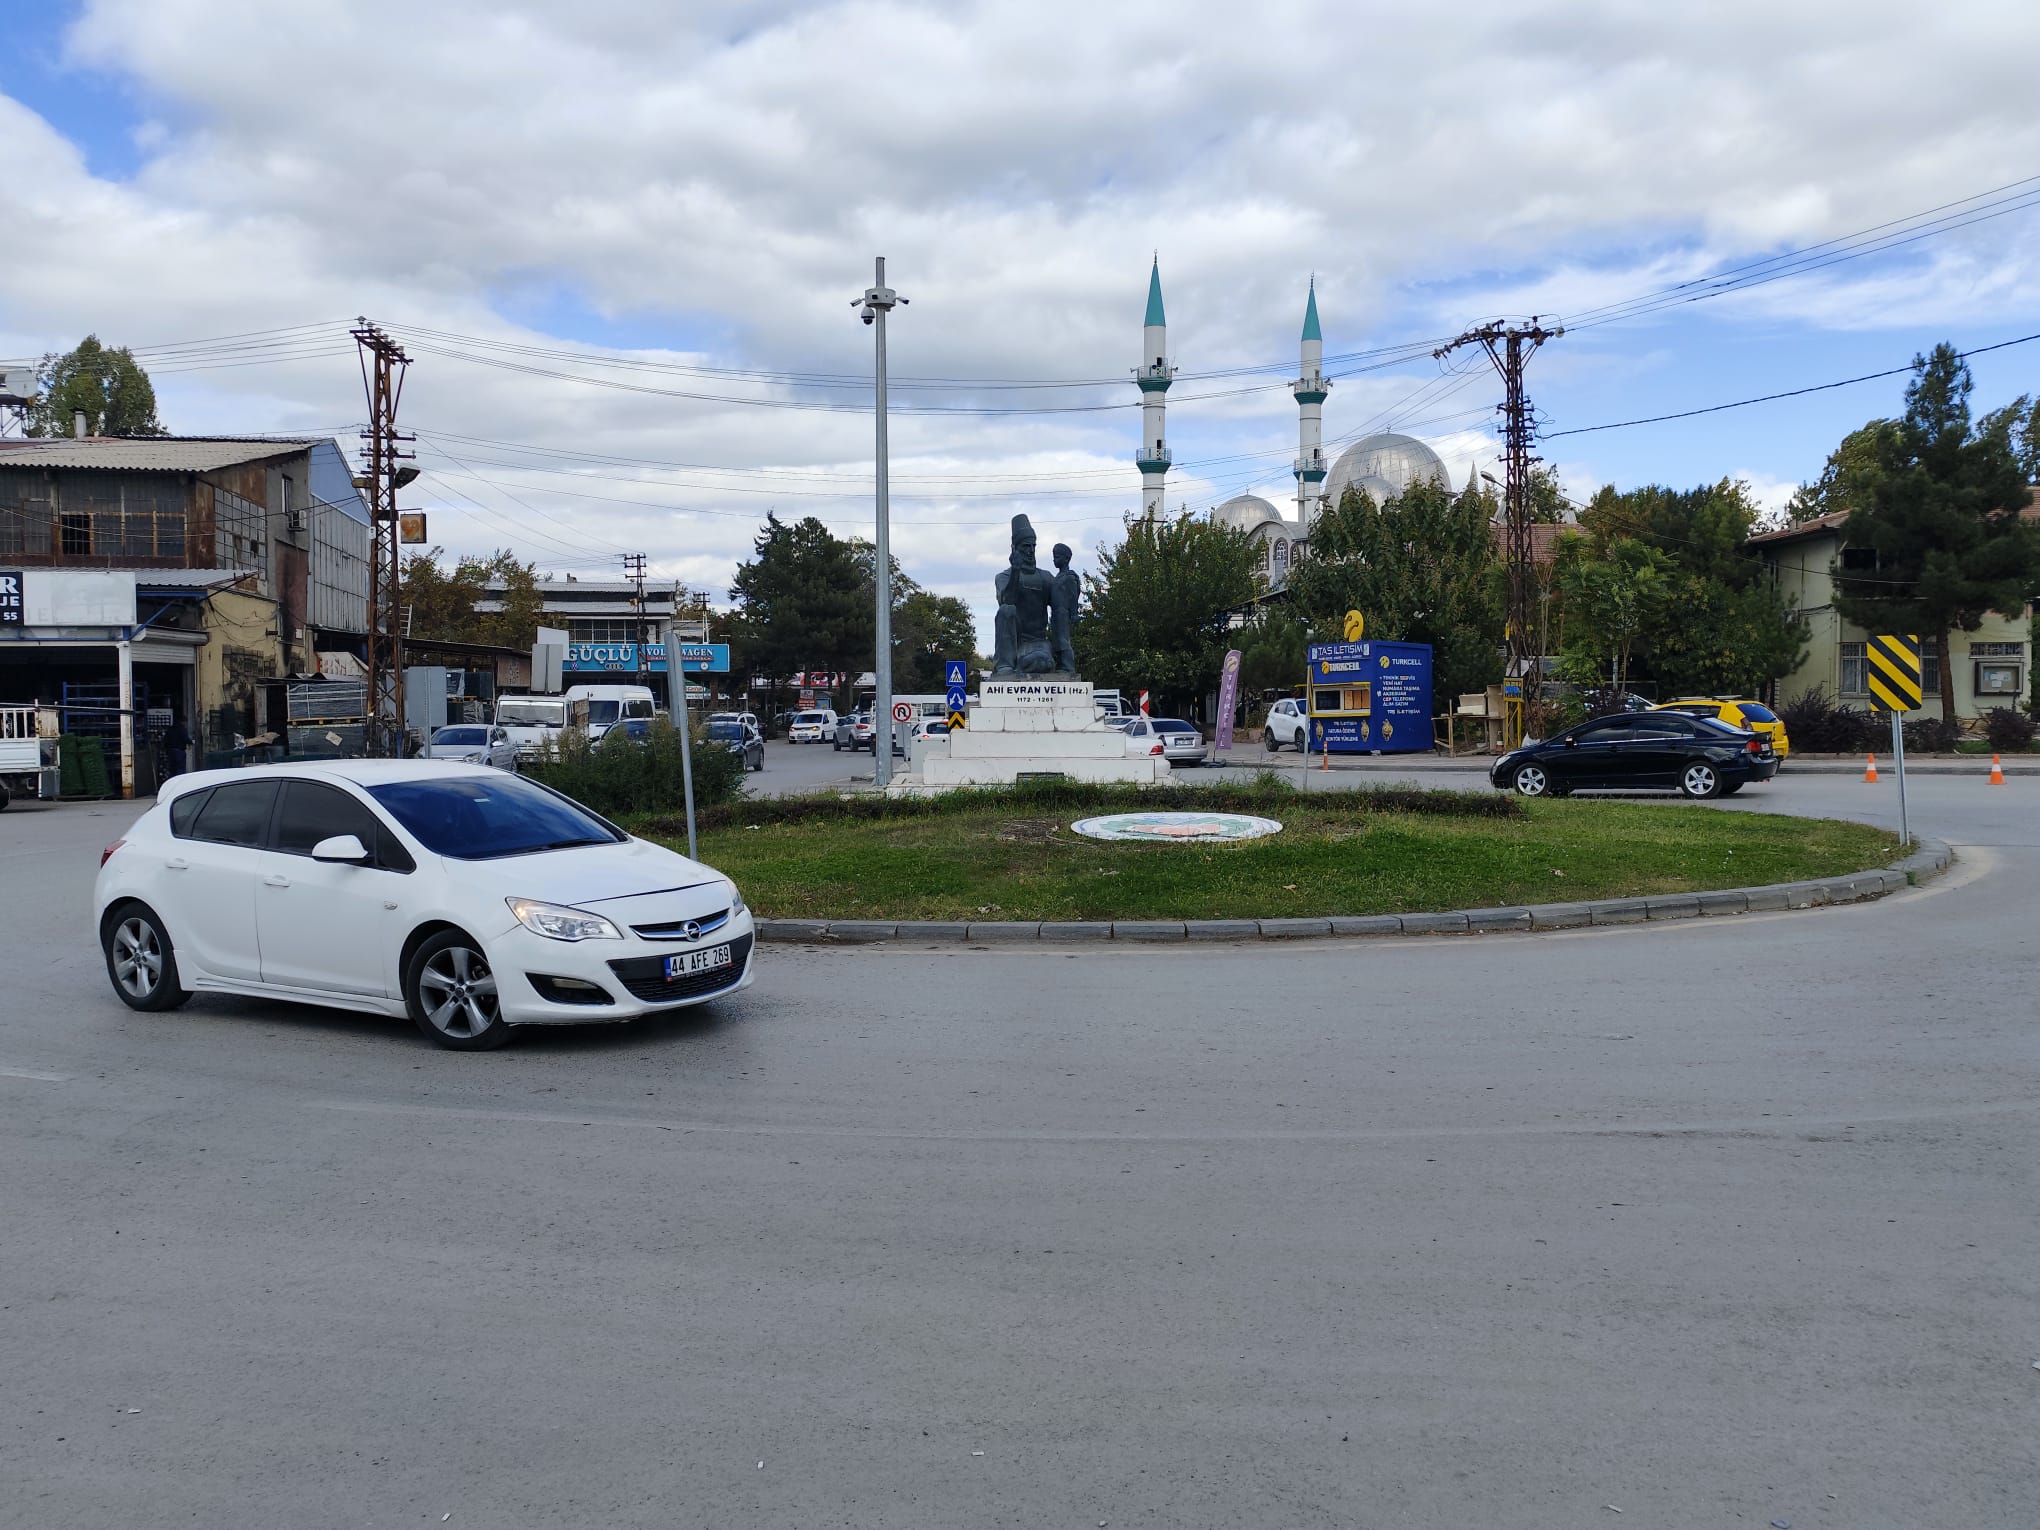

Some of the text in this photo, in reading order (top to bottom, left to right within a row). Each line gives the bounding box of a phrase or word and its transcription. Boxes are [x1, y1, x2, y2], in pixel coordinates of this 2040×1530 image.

[3, 611, 18, 621] 55
[567, 645, 632, 664] GÜÇLÜ
[647, 648, 713, 656] VOLWAGEN
[1329, 662, 1360, 671] TURKCELL
[1392, 658, 1422, 666] TURKCELL
[987, 686, 1089, 695] AHİ EVRAN VELİ (Hz.)
[672, 957, 685, 974] 44
[691, 952, 708, 970] AFE
[713, 947, 729, 964] 269
